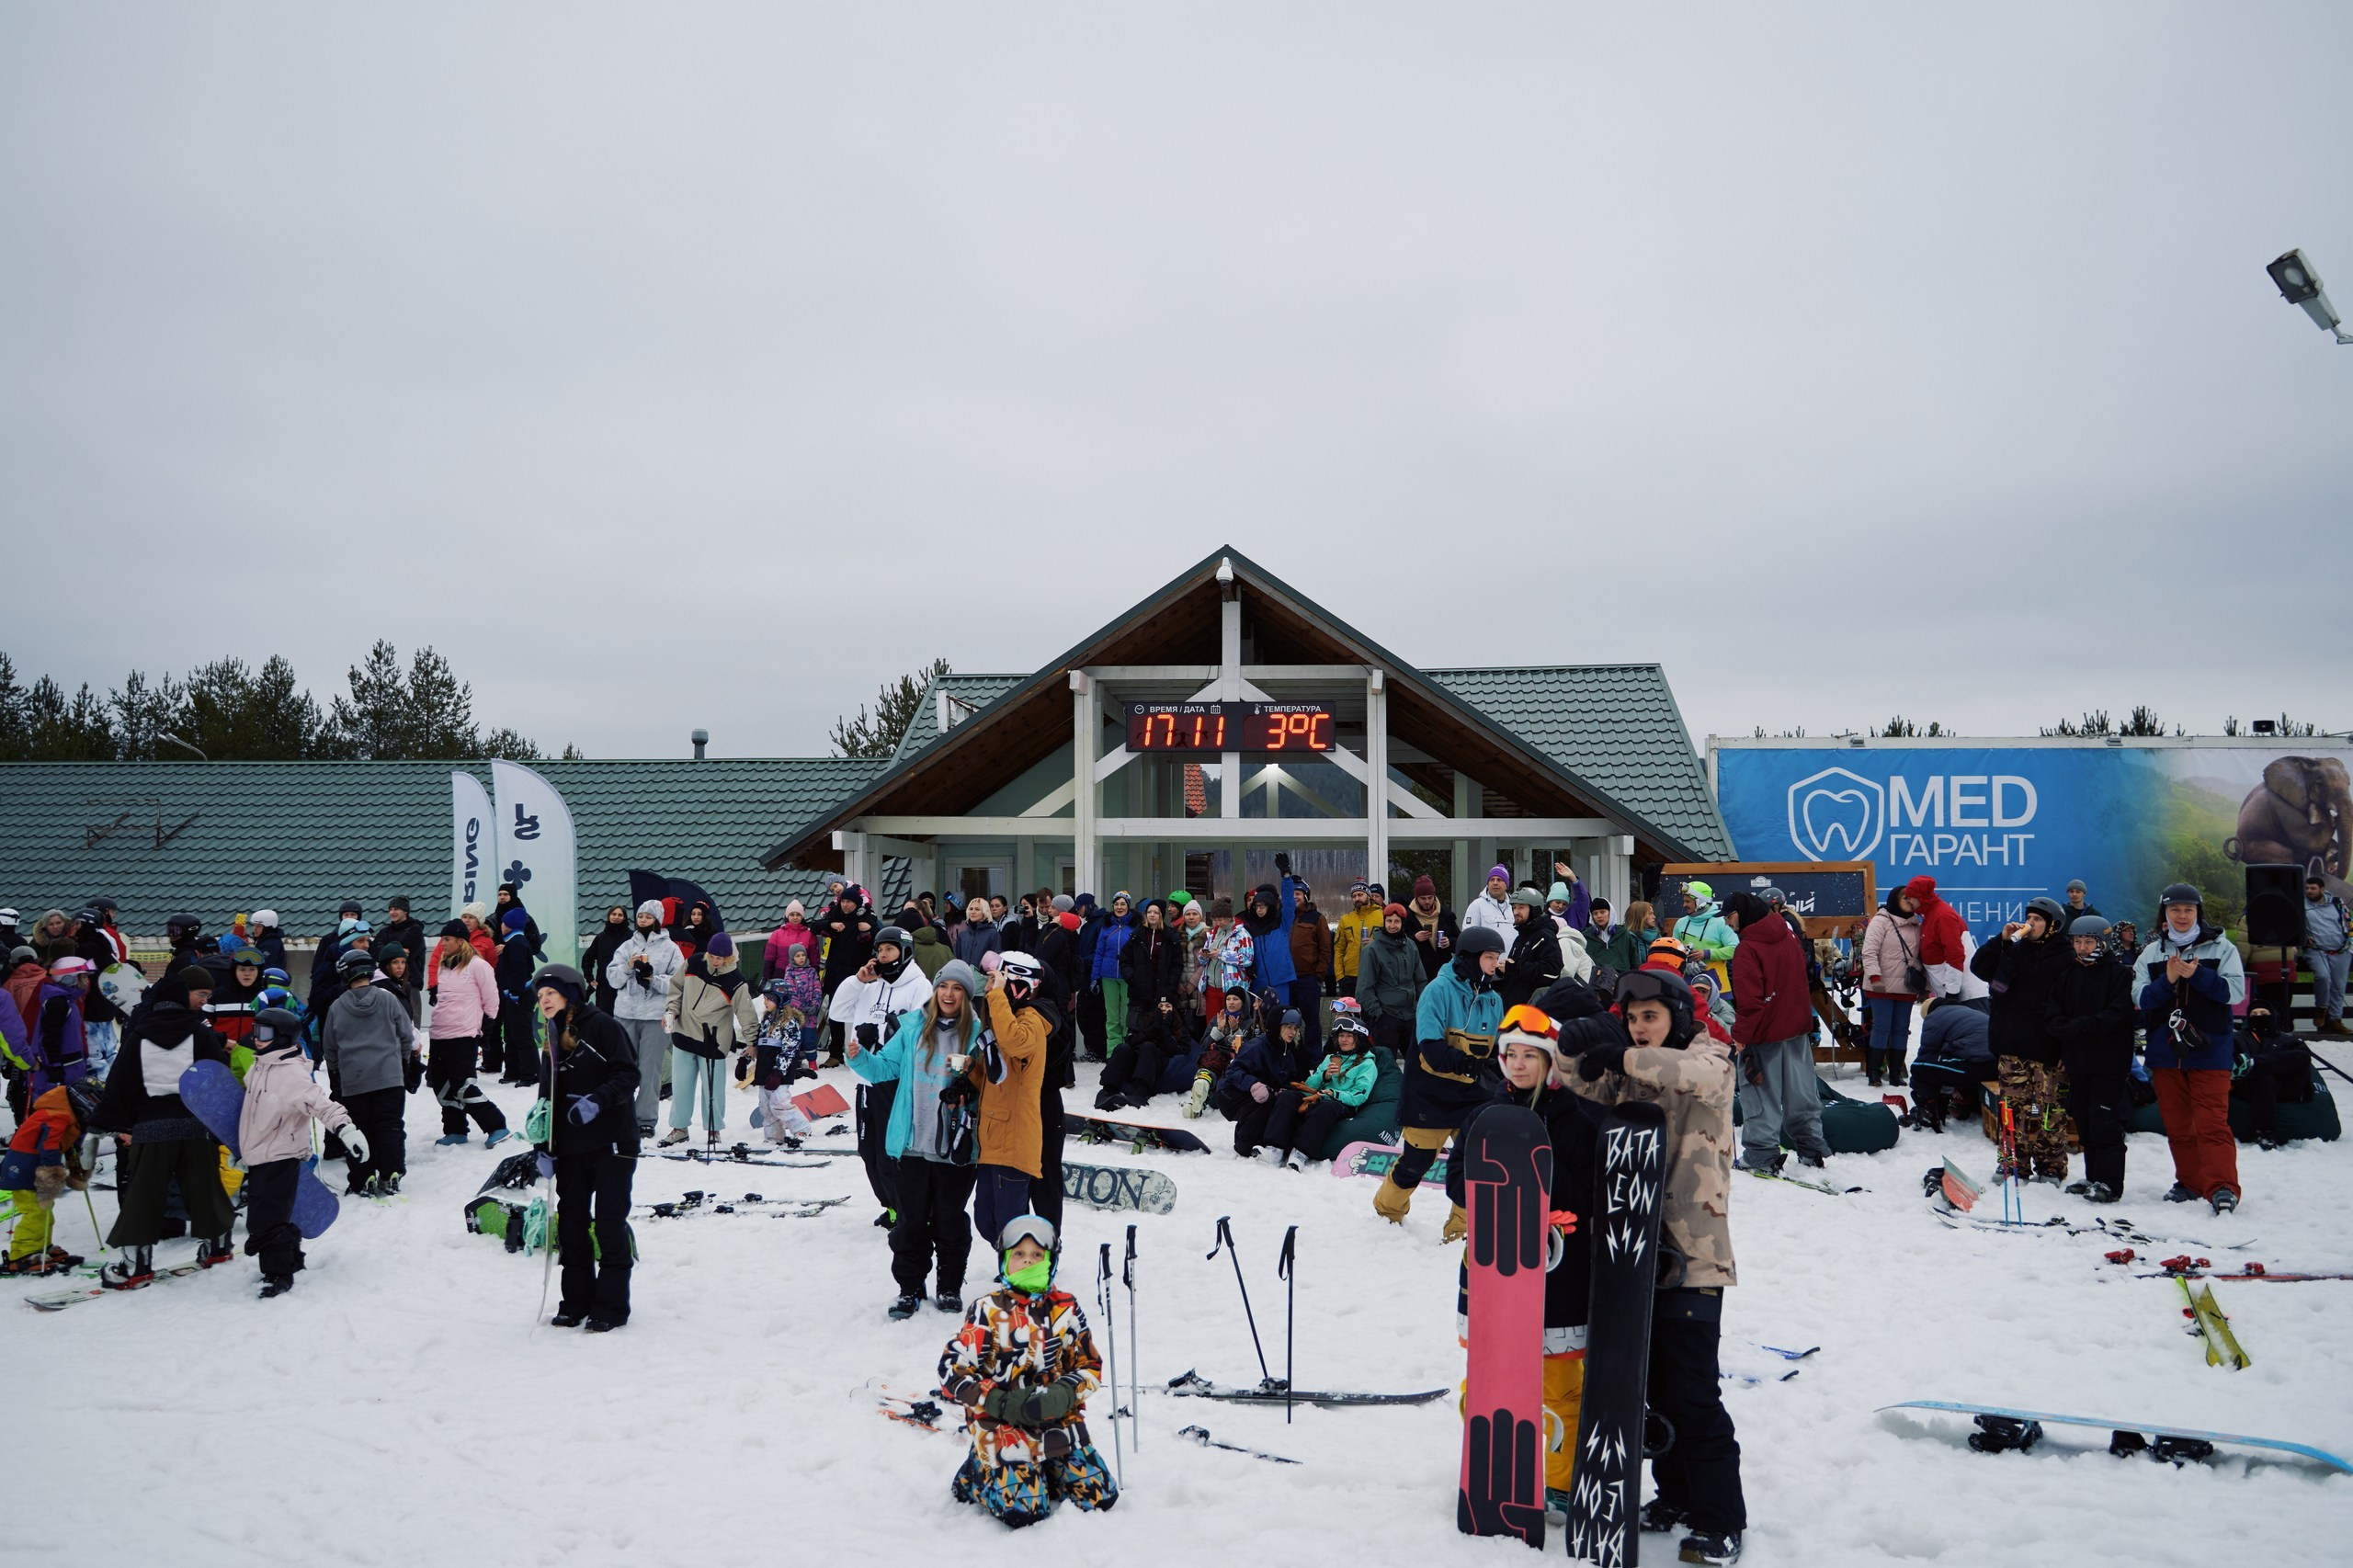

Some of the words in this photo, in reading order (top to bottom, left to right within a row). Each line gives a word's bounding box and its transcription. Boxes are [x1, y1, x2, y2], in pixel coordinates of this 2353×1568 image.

[1149, 705, 1178, 713] ВРЕМЯ
[1184, 705, 1205, 714] ДАТА
[1263, 704, 1322, 713] ТЕМПЕРАТУРА
[1890, 775, 2038, 827] MED
[1889, 833, 2035, 867] ГАРАНТ
[1605, 1125, 1660, 1176] BATA
[1606, 1172, 1657, 1215] LEON
[1573, 1472, 1625, 1523] LEON
